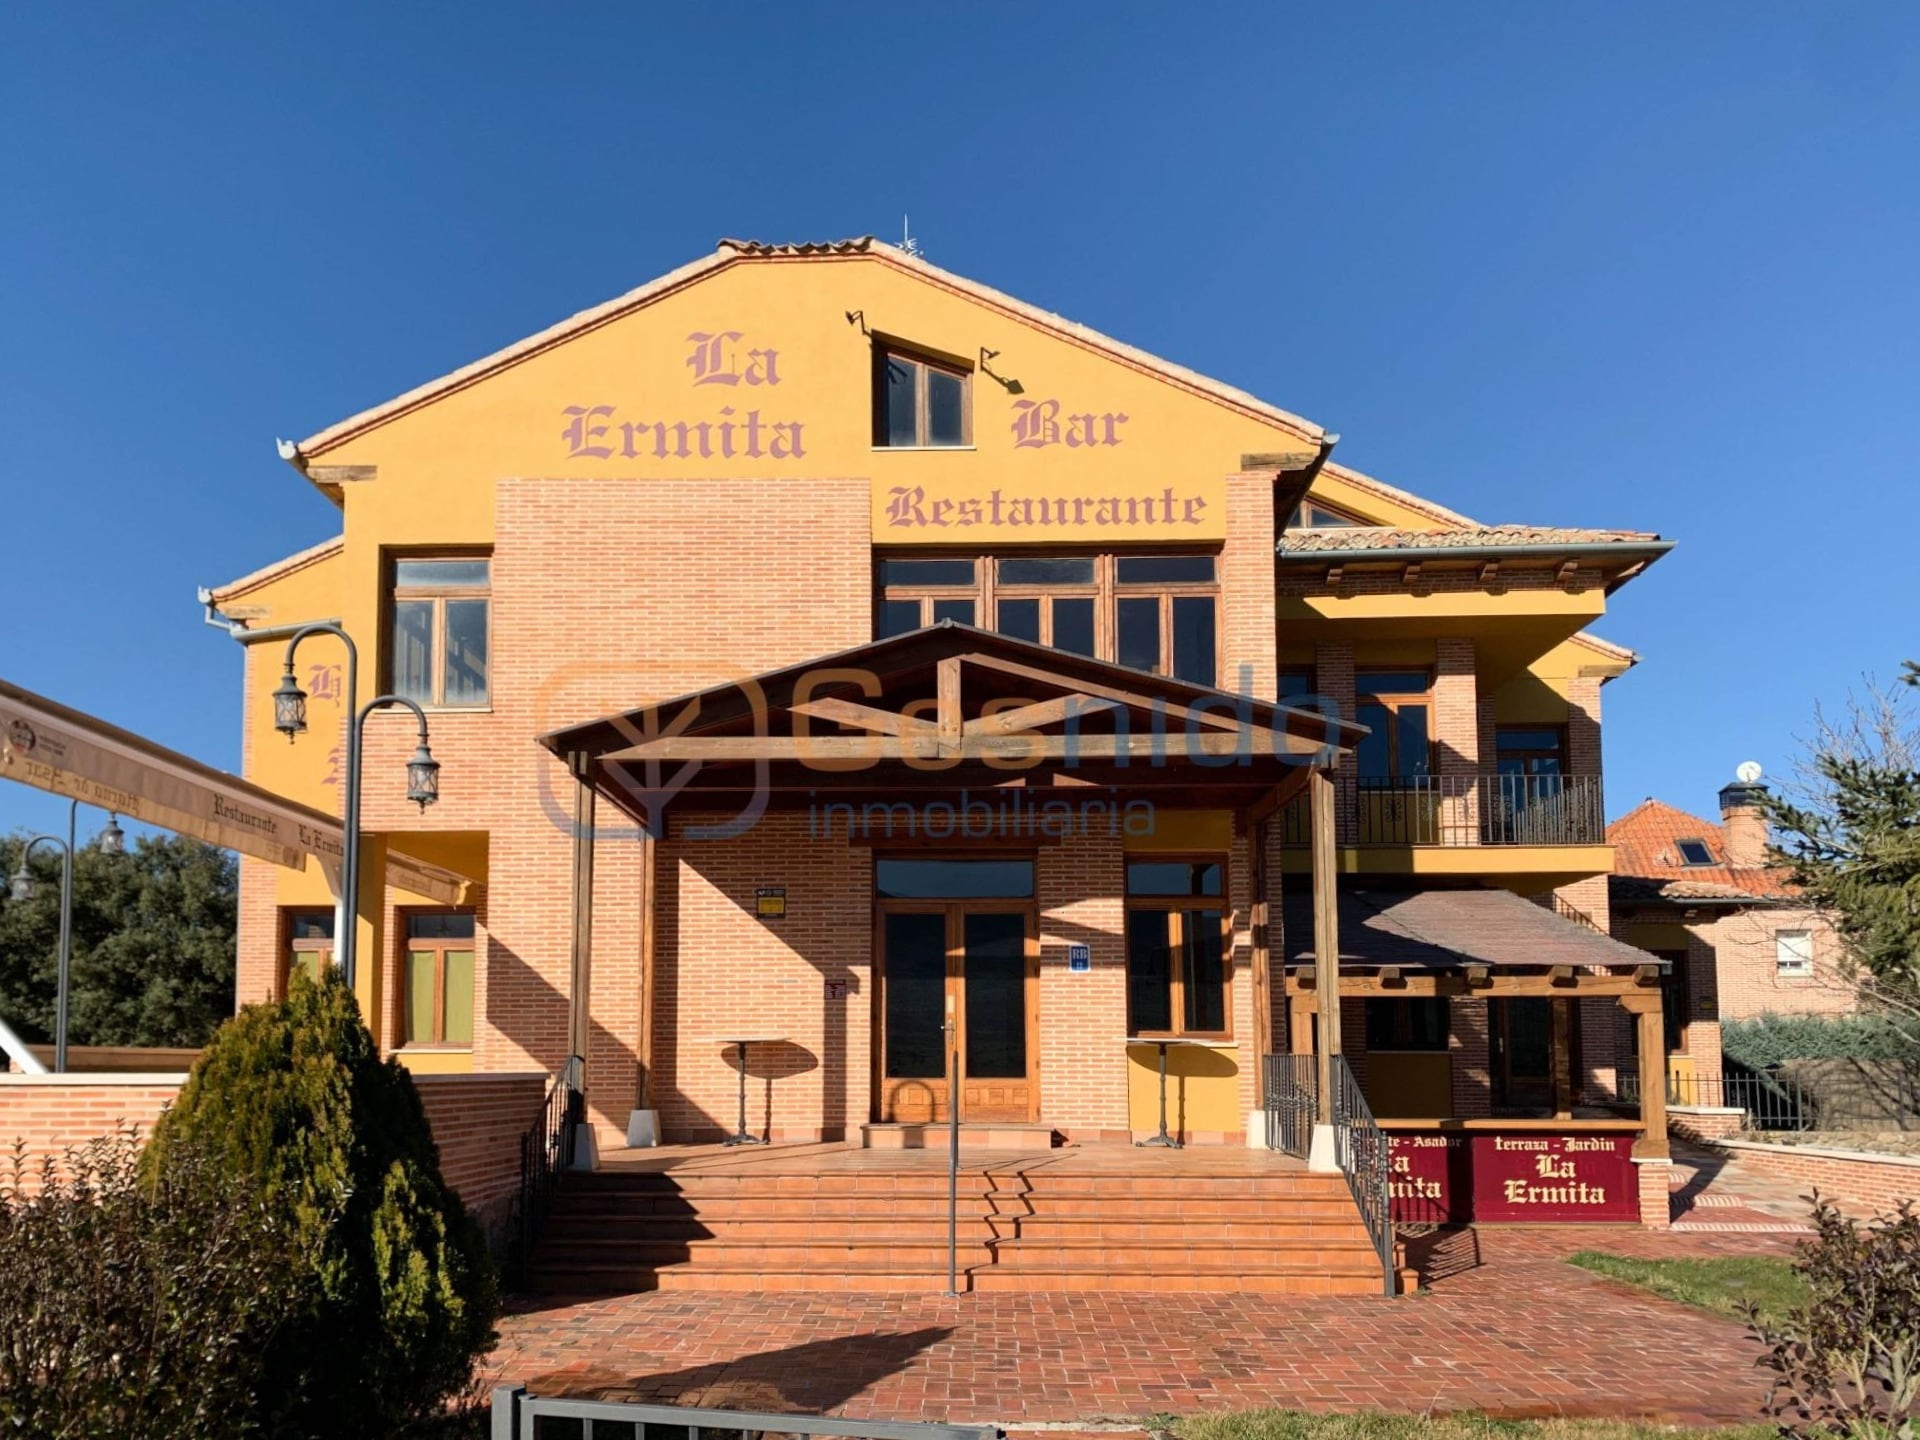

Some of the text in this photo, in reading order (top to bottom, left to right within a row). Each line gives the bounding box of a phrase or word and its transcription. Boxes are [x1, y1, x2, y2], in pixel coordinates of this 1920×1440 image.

[685, 331, 782, 389] La
[561, 405, 807, 461] Ermita
[1010, 399, 1130, 450] Bar
[886, 484, 1208, 529] Restaurante
[213, 792, 278, 835] Restaurante
[1413, 1136, 1461, 1148] Asador
[1494, 1136, 1549, 1151] terraza
[1561, 1137, 1615, 1152] Jardin
[1535, 1154, 1576, 1178] La
[1504, 1179, 1606, 1204] Ermita
